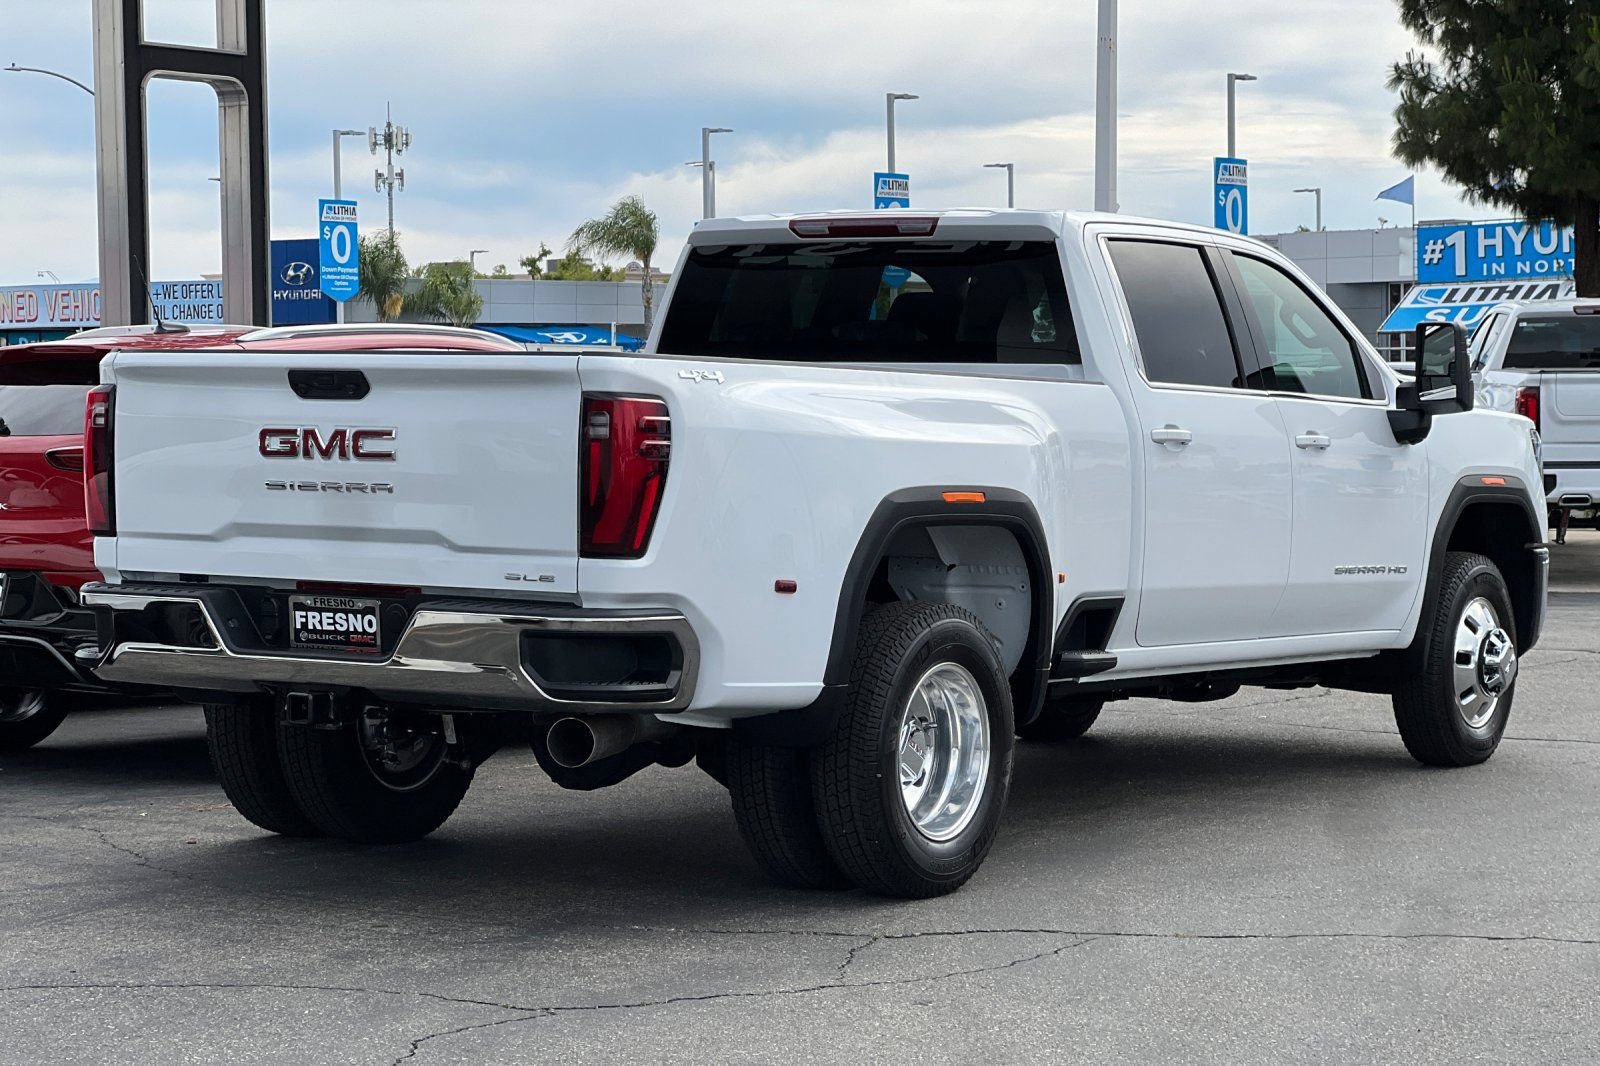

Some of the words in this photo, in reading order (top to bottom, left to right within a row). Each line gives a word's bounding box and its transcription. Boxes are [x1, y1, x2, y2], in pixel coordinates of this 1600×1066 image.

[1228, 165, 1247, 177] LITHIA
[887, 179, 909, 191] LITHIA
[333, 205, 357, 217] LITHIA
[1423, 230, 1468, 276] #1
[1483, 263, 1505, 276] IN
[181, 283, 214, 300] OFFER
[273, 288, 321, 301] HYUNDAI
[1441, 284, 1560, 304] LITHIA
[153, 305, 169, 321] OIL
[172, 304, 214, 320] CHANGE
[259, 427, 396, 461] GMC
[265, 480, 394, 494] SIERRA
[1334, 565, 1386, 575] SIERRA
[1387, 565, 1408, 574] HD
[504, 572, 555, 583] SLE
[313, 597, 355, 608] FRESNO
[294, 610, 377, 634] FRESNO
[308, 633, 346, 641] BUICK
[349, 634, 375, 644] GMC
